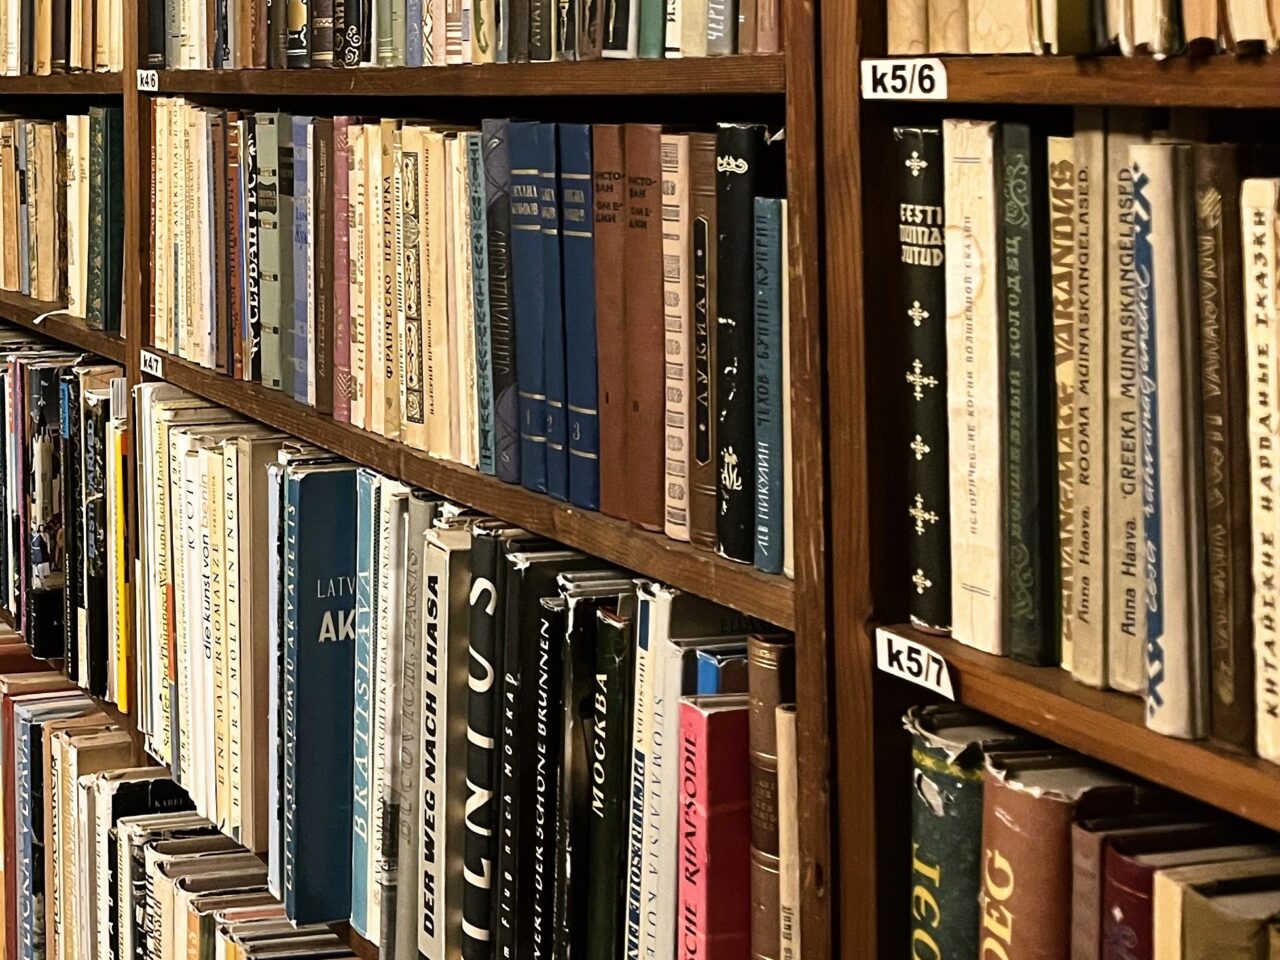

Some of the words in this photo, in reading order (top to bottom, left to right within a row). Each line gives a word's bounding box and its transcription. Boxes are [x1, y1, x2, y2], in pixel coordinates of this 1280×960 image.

[870, 65, 936, 94] k5/6
[383, 175, 394, 263] ПЕТРАРКА
[899, 204, 944, 224] EESTI
[383, 274, 394, 379] ФРАНЧЕСКО
[696, 272, 709, 407] ЛУКИАН
[756, 374, 770, 427] ЧЕХОВ
[756, 440, 770, 520] НИКУЛИН
[1077, 405, 1090, 486] ROOMA
[200, 533, 209, 569] von
[756, 525, 770, 556] ЛЕВ
[1077, 506, 1091, 566] Haava.
[200, 573, 212, 623] kunst
[425, 573, 439, 686] LHASA
[1077, 575, 1091, 625] Anna
[200, 626, 212, 660] die
[886, 638, 945, 688] k5/7
[355, 569, 374, 843] BRATISLAVA
[423, 690, 438, 785] NACH
[590, 672, 609, 819] МОСКВА
[423, 787, 436, 865] WEG
[682, 731, 700, 887] RHAPSODIE
[422, 869, 436, 939] DER
